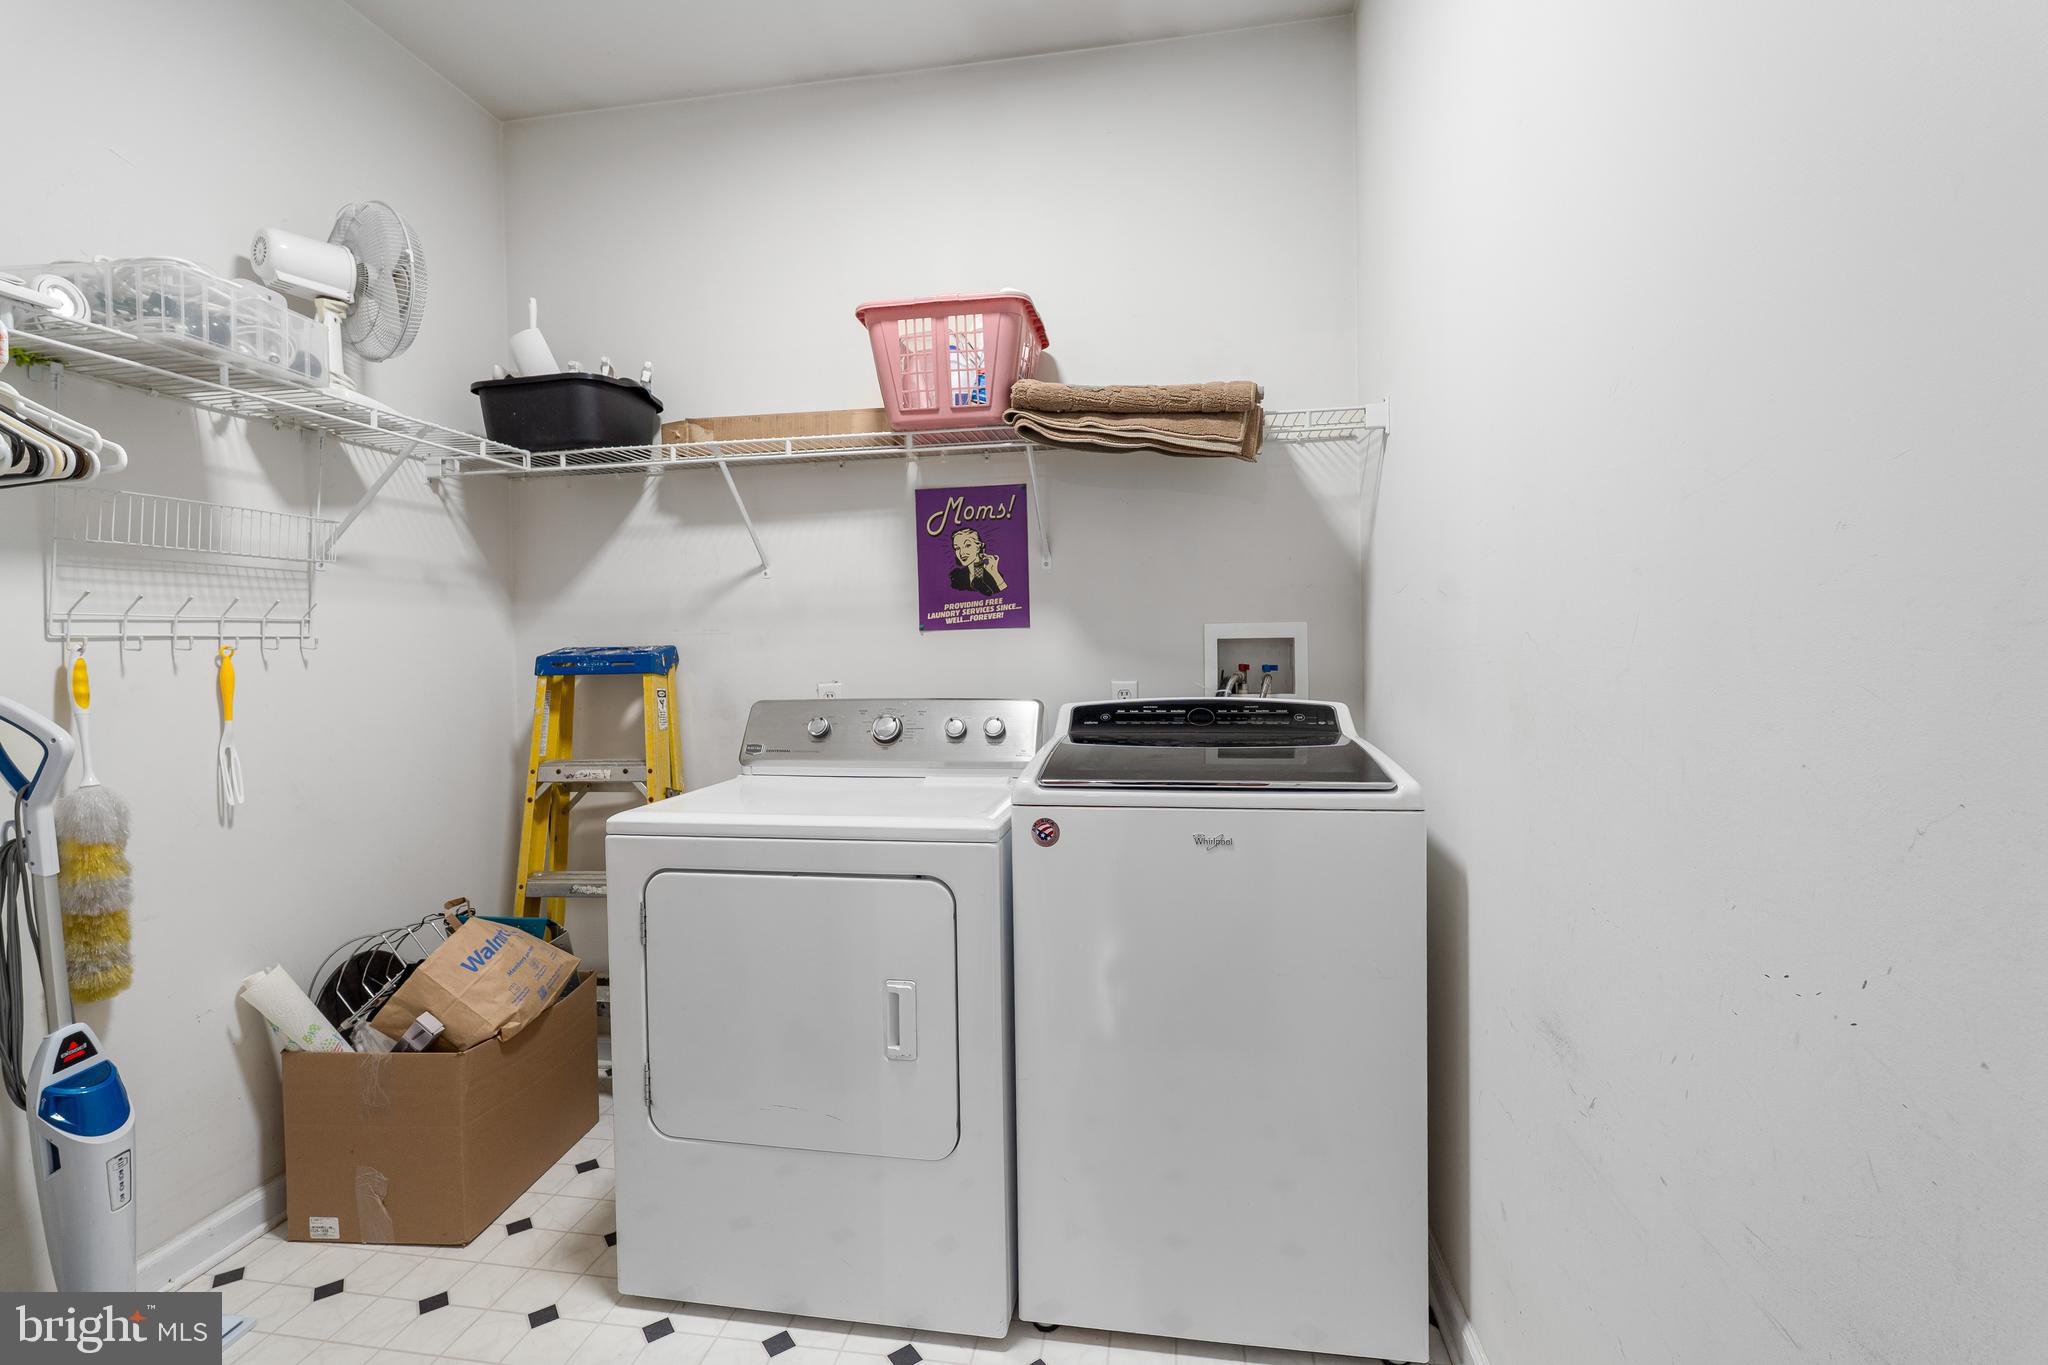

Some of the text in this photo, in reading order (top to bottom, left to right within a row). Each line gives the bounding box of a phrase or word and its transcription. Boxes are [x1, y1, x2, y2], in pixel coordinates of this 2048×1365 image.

[926, 494, 1016, 536] Moms!
[944, 597, 1004, 611] PROVIDING FREE
[927, 609, 961, 620] LAUNDRY
[961, 605, 995, 616] SERVICES
[1193, 834, 1233, 849] Whirlpool
